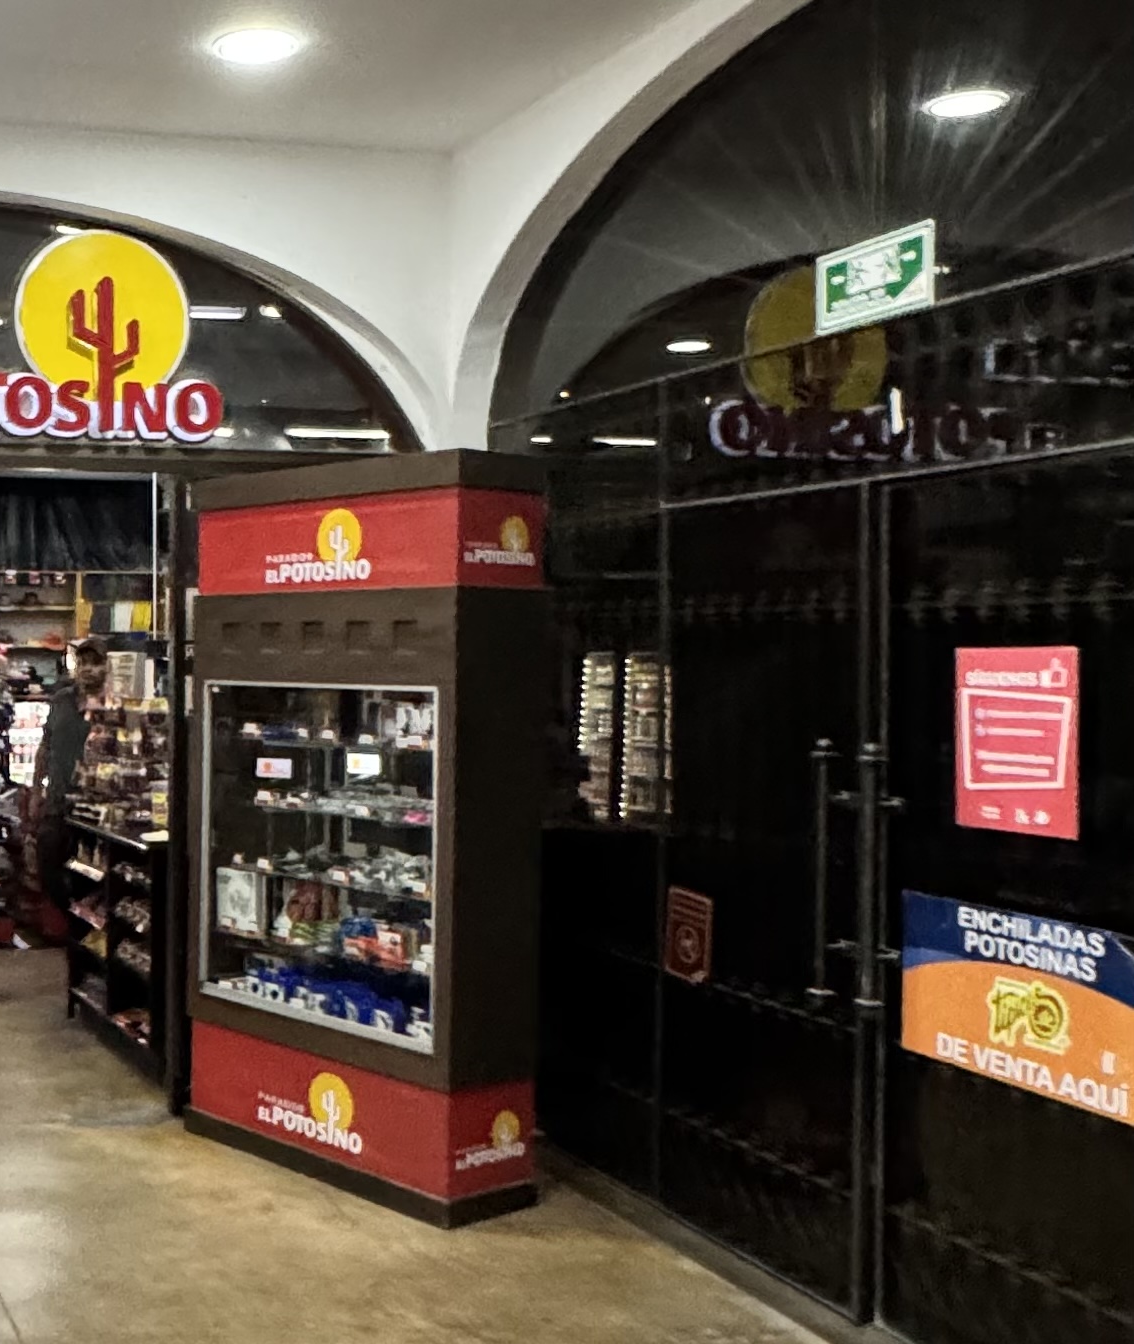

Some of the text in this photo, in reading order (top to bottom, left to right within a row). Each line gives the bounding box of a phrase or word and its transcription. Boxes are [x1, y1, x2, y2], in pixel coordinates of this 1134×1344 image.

[265, 558, 372, 584] EL POTOSINO
[957, 906, 1106, 957] ENCHILADAS
[965, 930, 1098, 983] POTOSINAS
[936, 1032, 970, 1065] DE
[973, 1043, 1055, 1093] VENTA
[257, 1105, 363, 1155] EL POTOSINO
